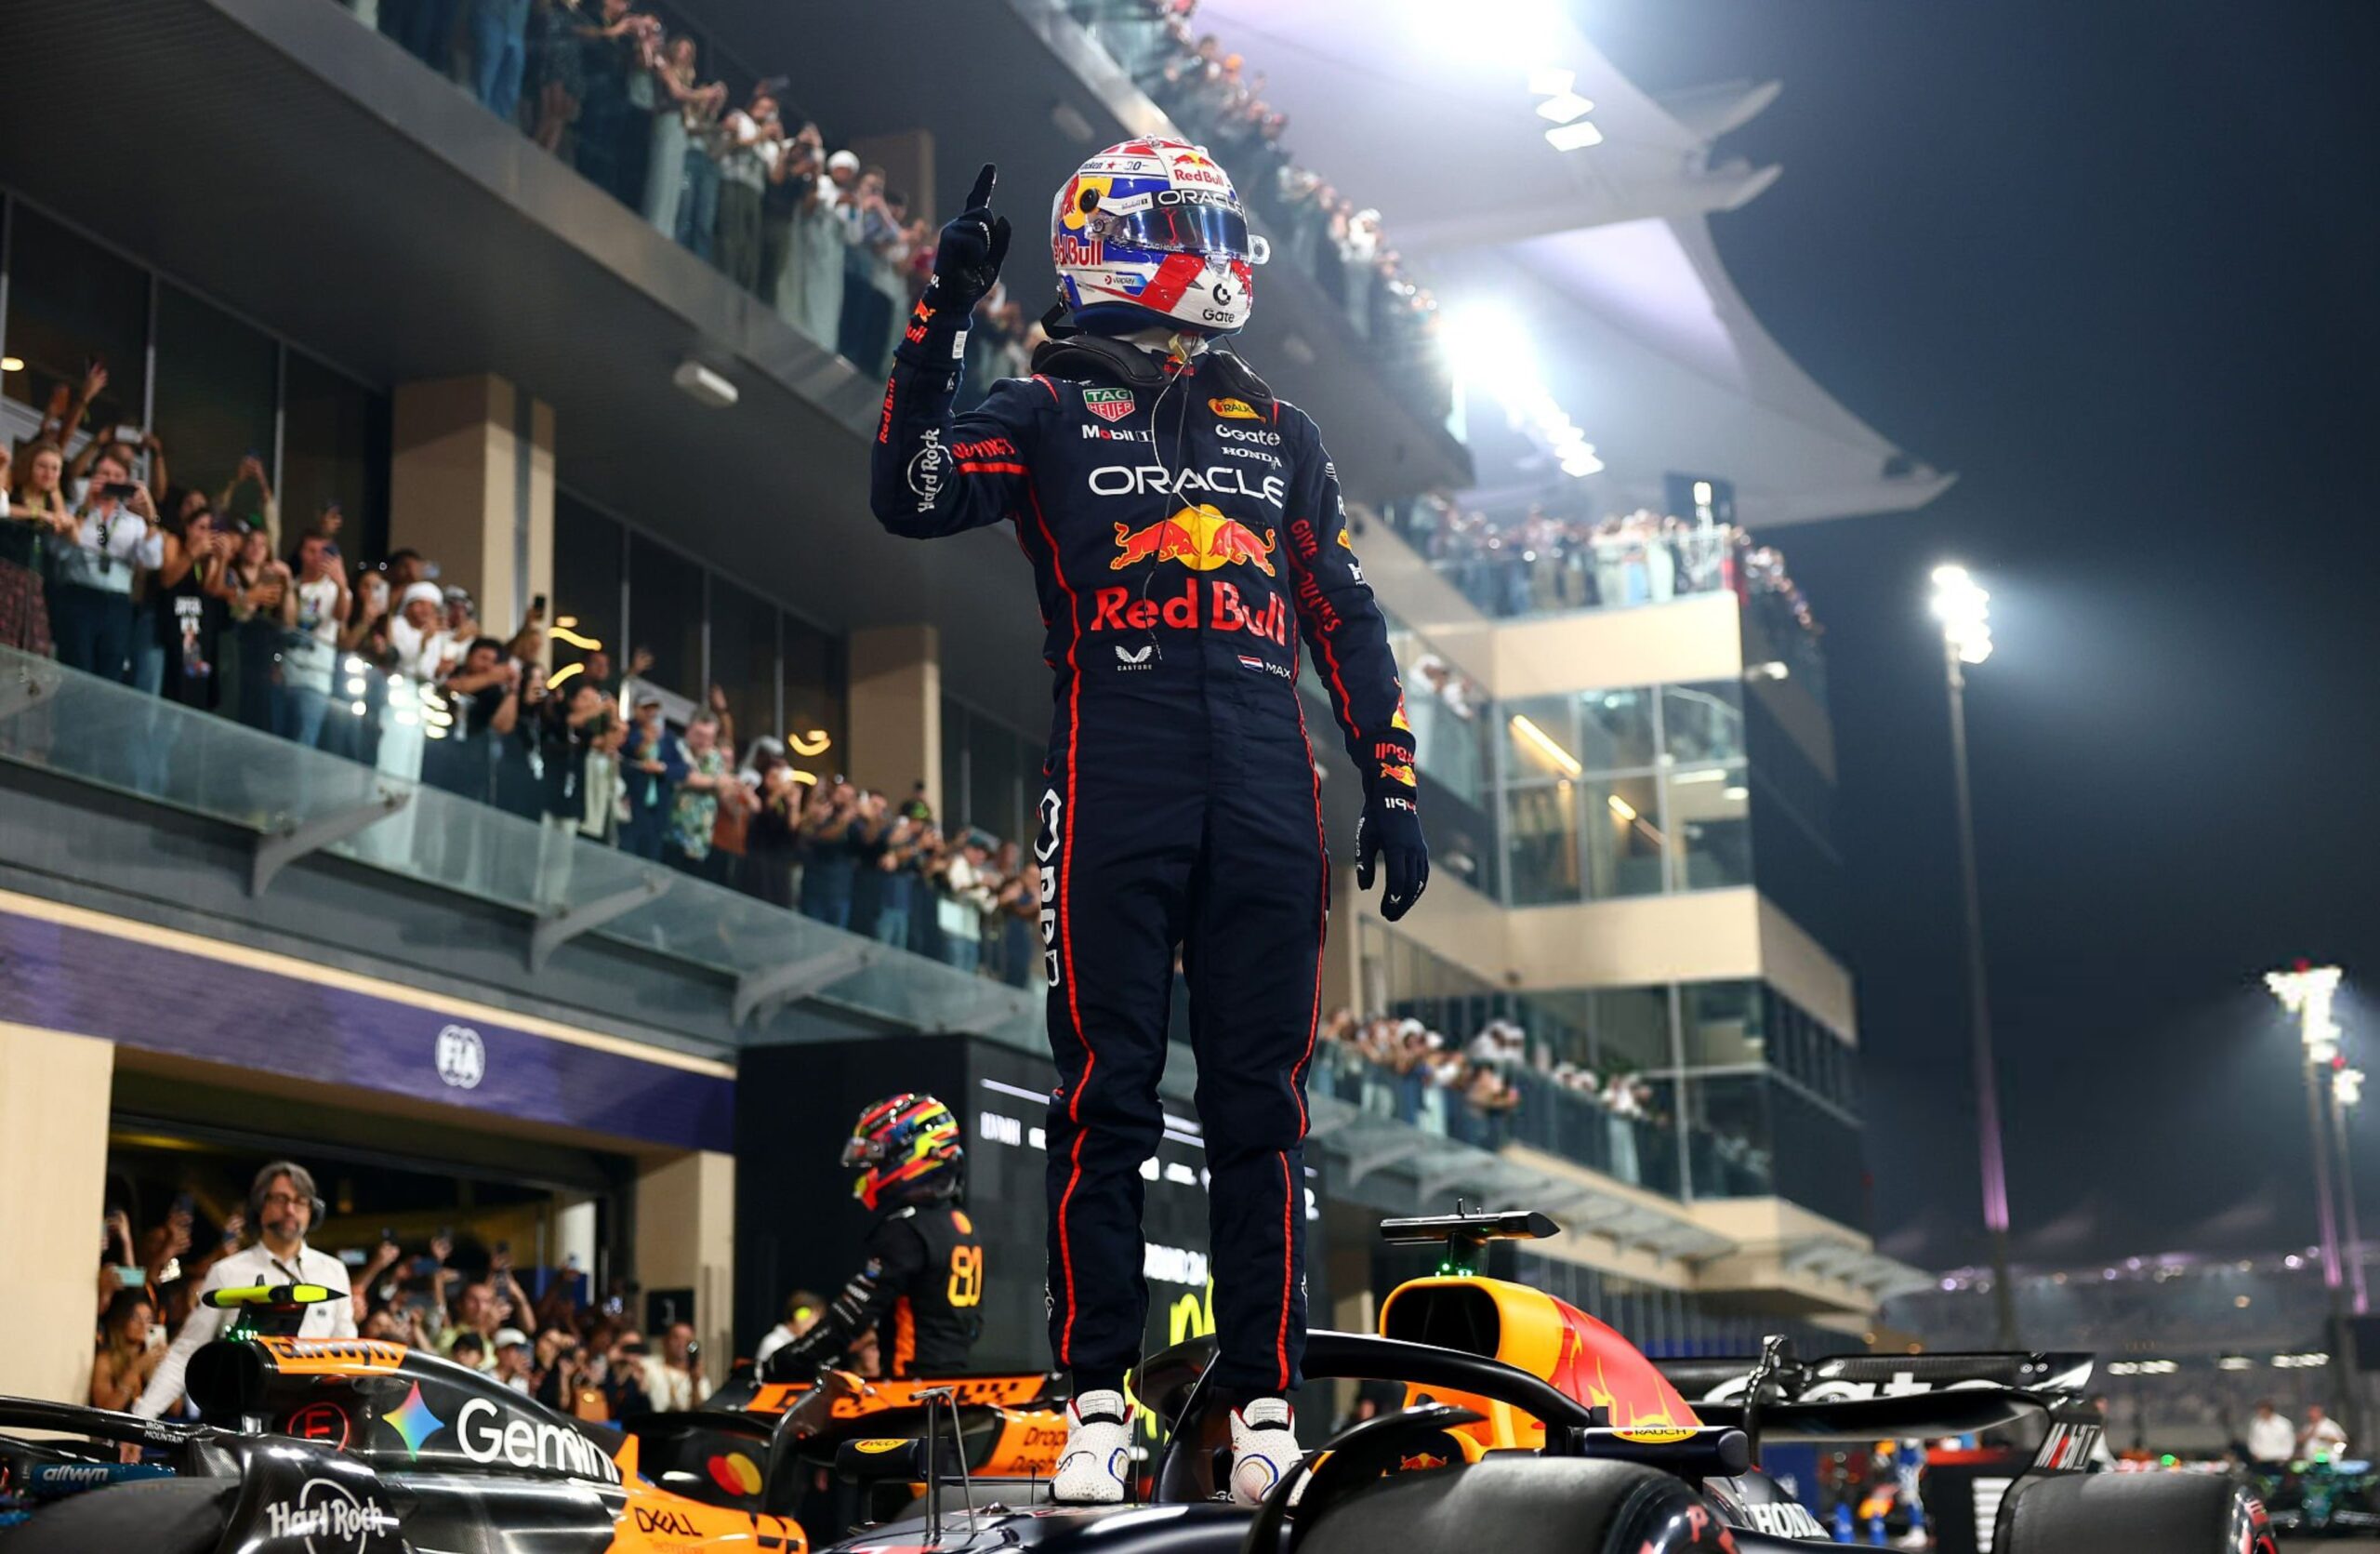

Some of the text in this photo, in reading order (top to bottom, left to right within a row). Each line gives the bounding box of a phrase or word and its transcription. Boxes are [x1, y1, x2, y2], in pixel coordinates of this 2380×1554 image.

[1173, 169, 1224, 187] Red Bull
[1157, 190, 1245, 218] ORACLE
[1066, 235, 1104, 266] Bull
[1202, 308, 1235, 324] Gate
[1087, 390, 1130, 402] TAG
[1088, 401, 1133, 418] HEUER
[1082, 425, 1134, 442] Mobil
[918, 428, 940, 513] Hard Rock
[1222, 446, 1282, 469] HONDA
[1089, 466, 1285, 510] ORACLE
[1290, 519, 1318, 561] GIVE
[1091, 578, 1286, 647] Red Bull
[1265, 661, 1291, 679] MAX
[947, 1244, 983, 1308] 81
[143, 1430, 185, 1443] MOUNTAIN
[330, 1495, 386, 1542] Rock
[634, 1507, 703, 1537] DELL
